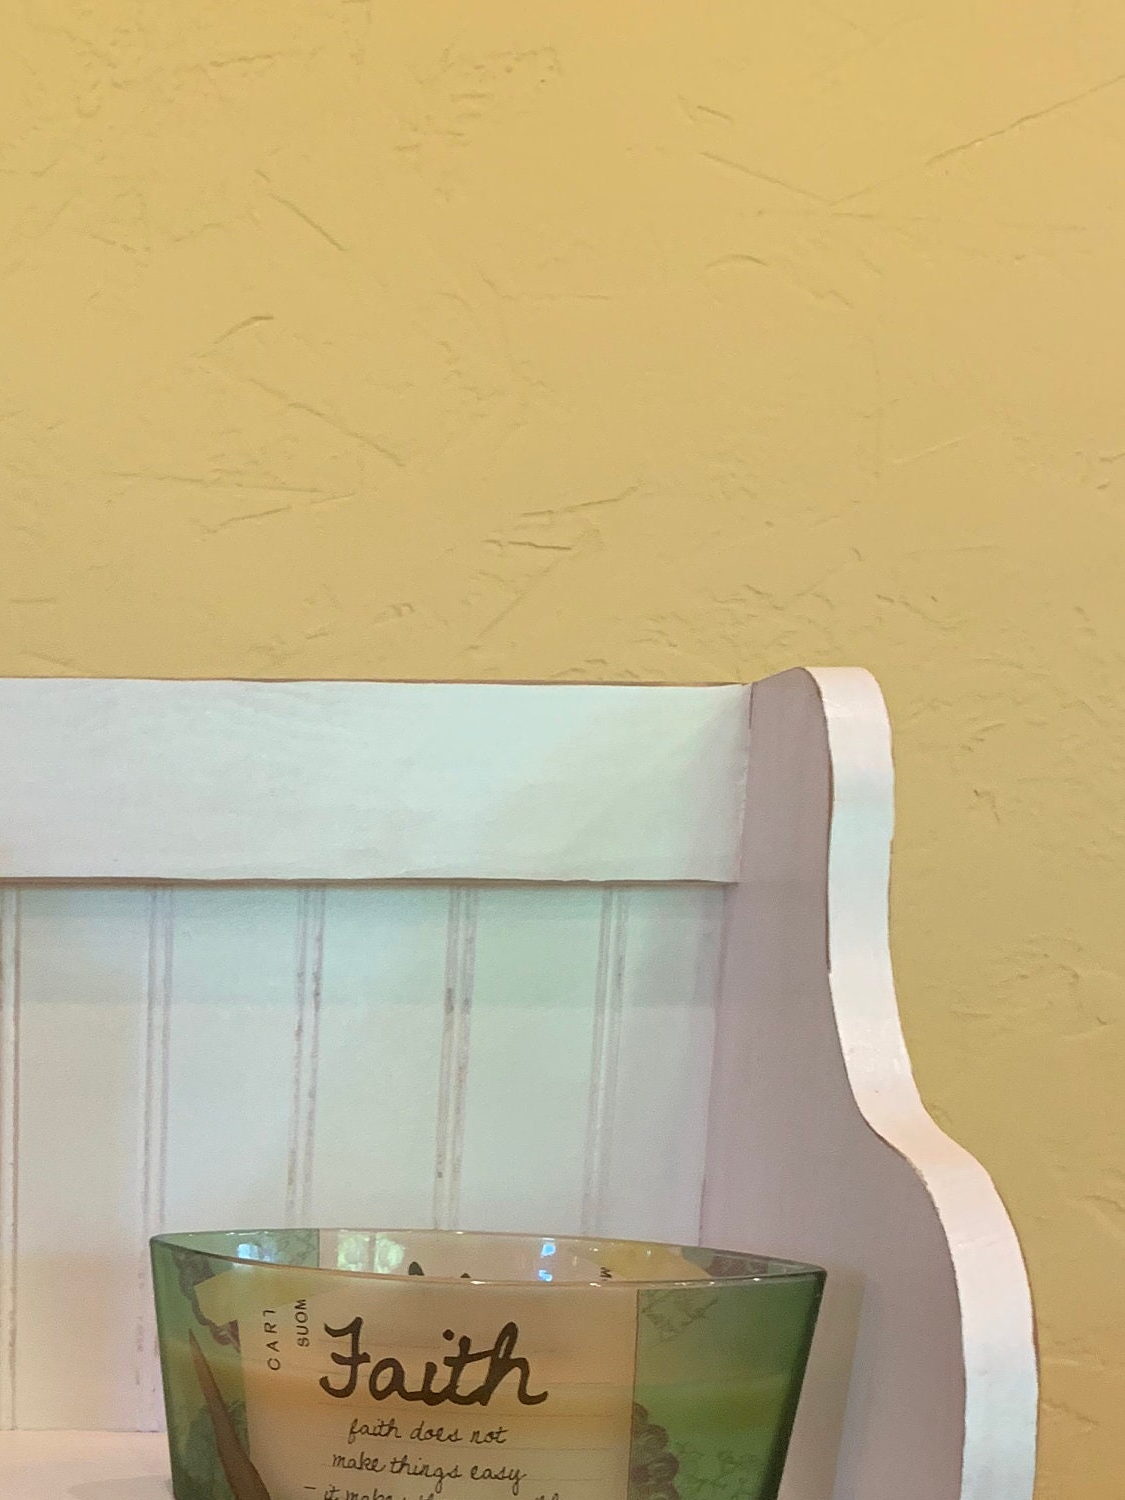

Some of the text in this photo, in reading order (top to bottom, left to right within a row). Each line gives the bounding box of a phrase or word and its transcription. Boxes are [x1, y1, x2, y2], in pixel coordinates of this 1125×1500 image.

[319, 1316, 548, 1406] Faith
[347, 1418, 509, 1444] faith does not
[332, 1451, 527, 1496] make things easy
